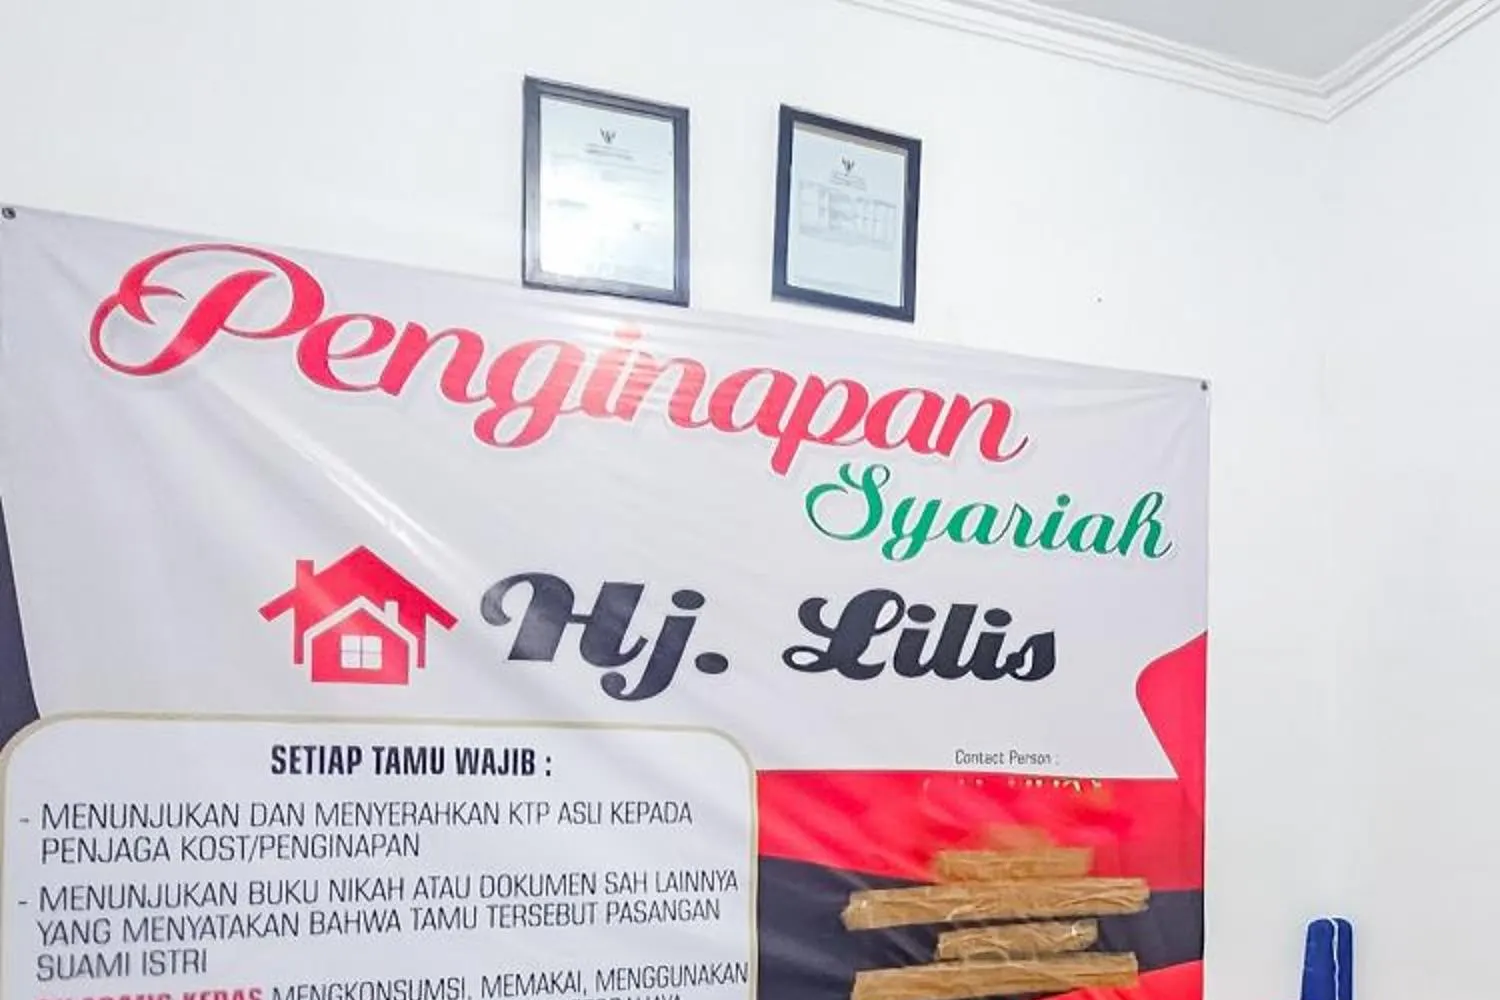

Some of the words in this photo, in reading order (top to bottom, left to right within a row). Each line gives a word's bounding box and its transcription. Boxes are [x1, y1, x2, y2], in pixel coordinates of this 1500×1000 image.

[89, 243, 1029, 476] Penginapan
[805, 463, 1172, 561] Syariah
[479, 571, 729, 701] Hj.
[782, 587, 1056, 682] Lilis
[271, 744, 363, 776] SETIAP
[371, 746, 446, 777] TAMU
[454, 747, 537, 778] WAJIB
[954, 749, 1005, 766] Contact
[1008, 749, 1052, 766] Person
[41, 802, 240, 831] MENUNJUKAN
[250, 802, 305, 828] DAN
[314, 801, 500, 828] MENYERAHKAN
[508, 801, 550, 826] KTP
[557, 801, 602, 826] ASLI
[610, 801, 693, 826] KEPADA
[41, 836, 171, 865] PENJAGA
[181, 833, 420, 864] KOST/PENGINAPAN
[39, 881, 238, 912] MENUNJUKAN
[249, 879, 319, 906] BUKU
[329, 876, 404, 903] NIKAH
[412, 874, 471, 901] ATAU
[479, 872, 597, 899] DOKUMEN
[604, 871, 648, 895] SAH
[655, 869, 739, 893] LAINNYA
[37, 918, 111, 947] YANG
[122, 911, 299, 944] MENYATAKAN
[309, 908, 401, 936] BAHWA
[410, 904, 477, 932] TAMU
[486, 901, 599, 929] TERSEBUT
[605, 898, 721, 925] PASANGAN
[37, 951, 129, 983] SUAMI
[141, 948, 208, 976] ISTRI
[481, 970, 587, 999] MEMAKAI,
[595, 962, 749, 992] MENGGUNAKAN
